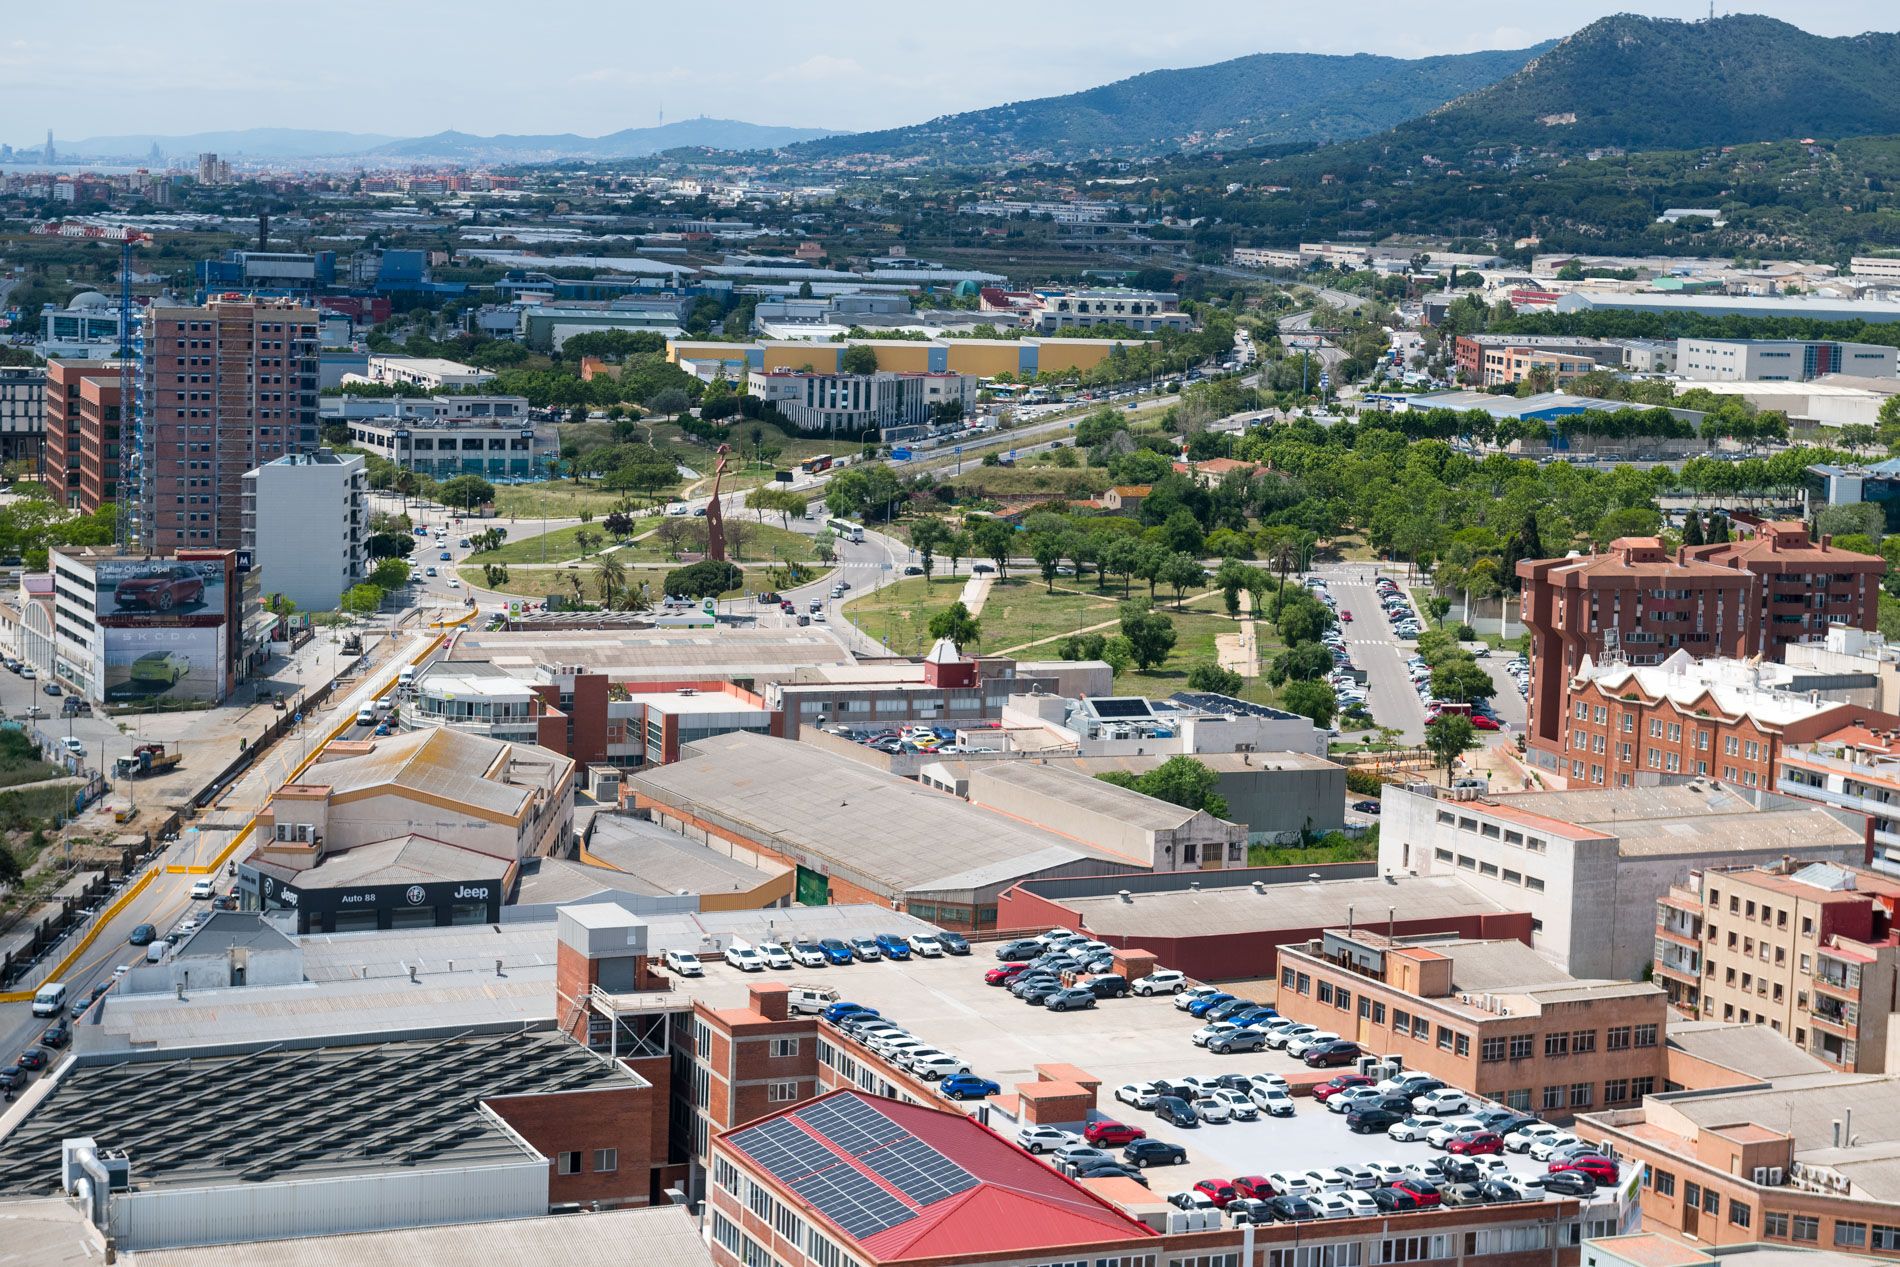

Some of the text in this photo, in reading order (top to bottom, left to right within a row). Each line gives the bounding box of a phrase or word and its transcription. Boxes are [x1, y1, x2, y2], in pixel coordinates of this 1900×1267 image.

[101, 564, 170, 574] Taller Oficial Opel
[280, 886, 299, 906] Jeep
[341, 893, 376, 904] Auto 88
[454, 885, 489, 900] Jeep
